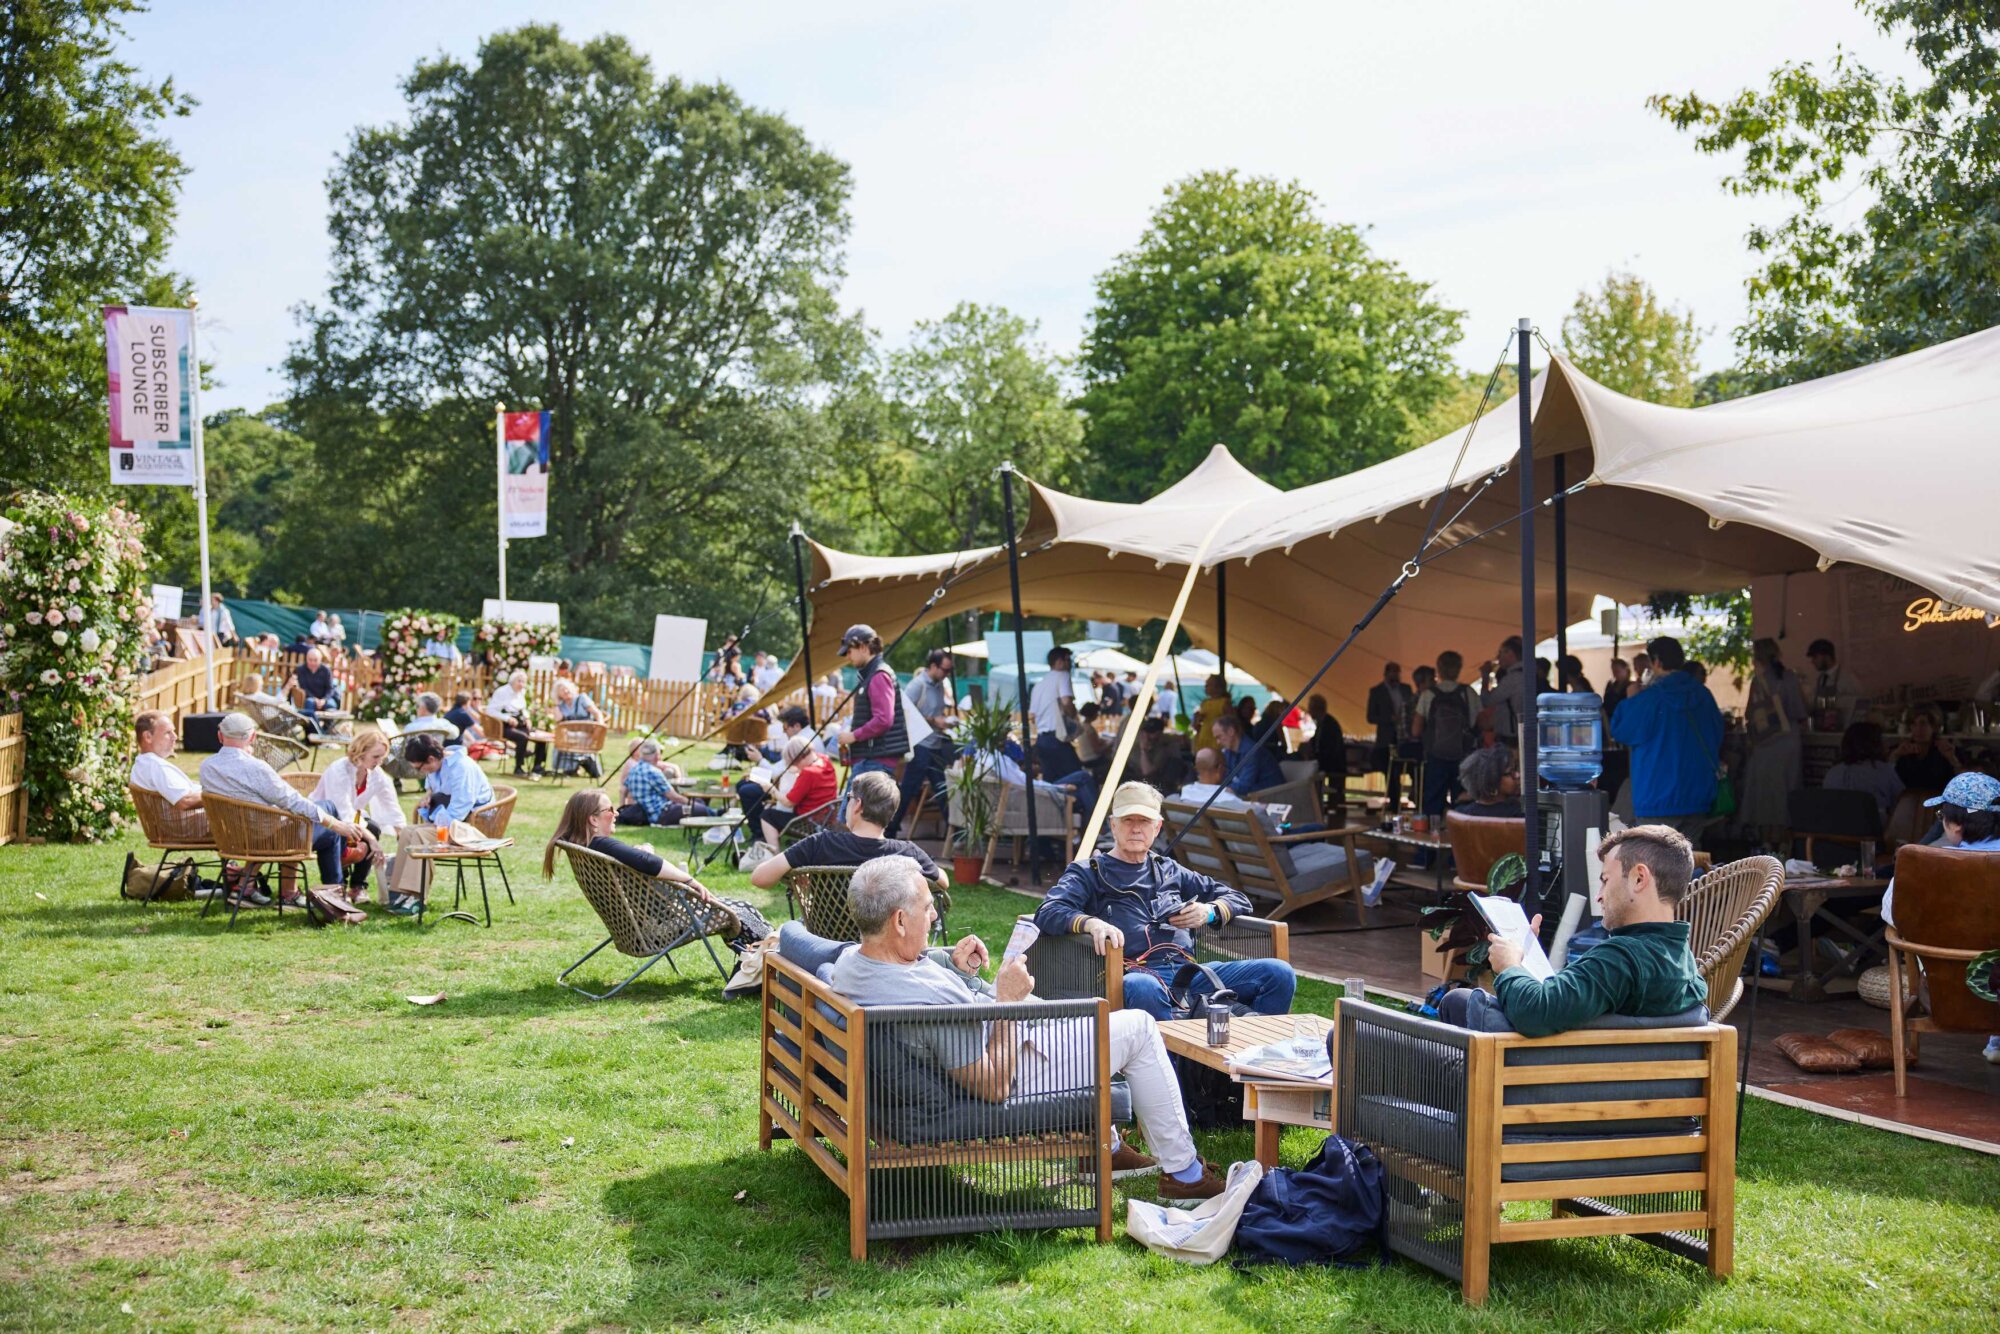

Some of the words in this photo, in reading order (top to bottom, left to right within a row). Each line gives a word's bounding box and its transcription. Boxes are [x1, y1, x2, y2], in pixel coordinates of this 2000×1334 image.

[131, 342, 149, 415] LOUNGE
[150, 325, 170, 434] SUBSCRIBER
[135, 453, 182, 464] VINTAGE
